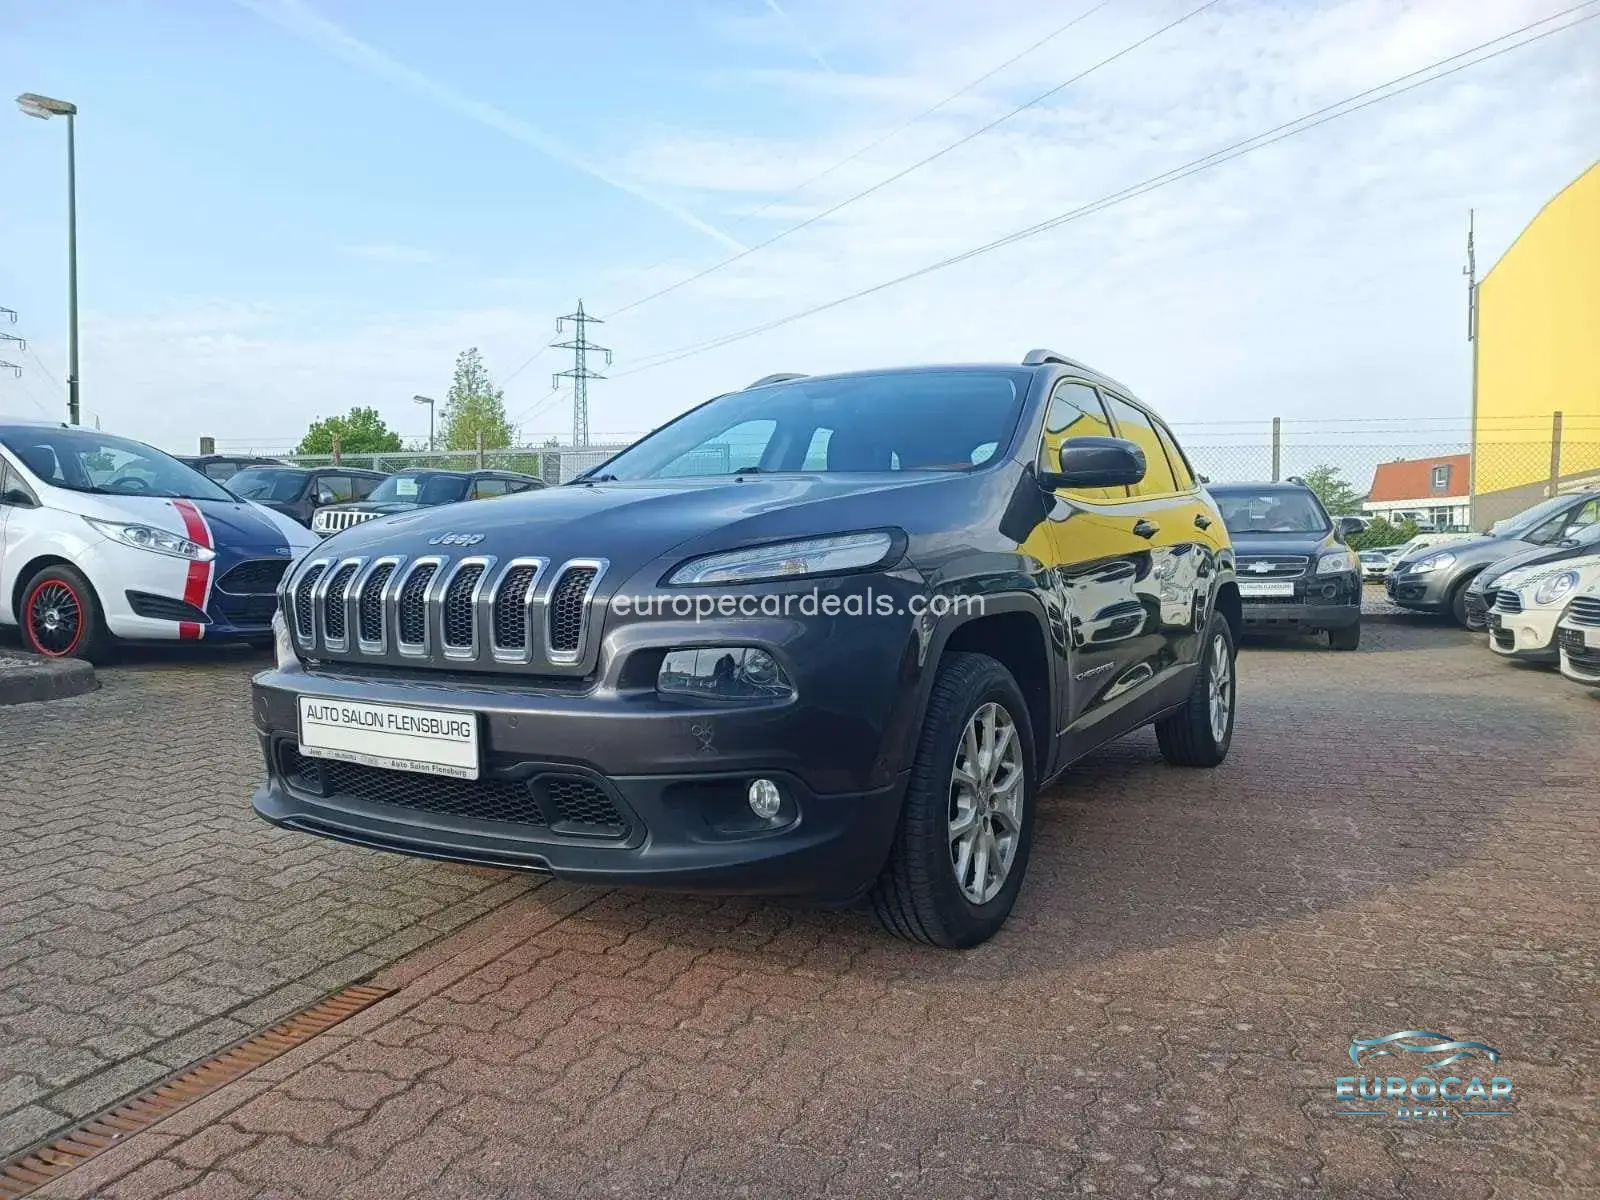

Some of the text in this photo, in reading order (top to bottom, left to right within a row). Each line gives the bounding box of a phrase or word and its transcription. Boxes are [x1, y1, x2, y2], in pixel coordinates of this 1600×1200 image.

[428, 531, 486, 547] Jeep
[307, 704, 471, 738] AUTO SALON FLENSBURG
[409, 762, 430, 772] Salon
[431, 764, 468, 777] Flensburg
